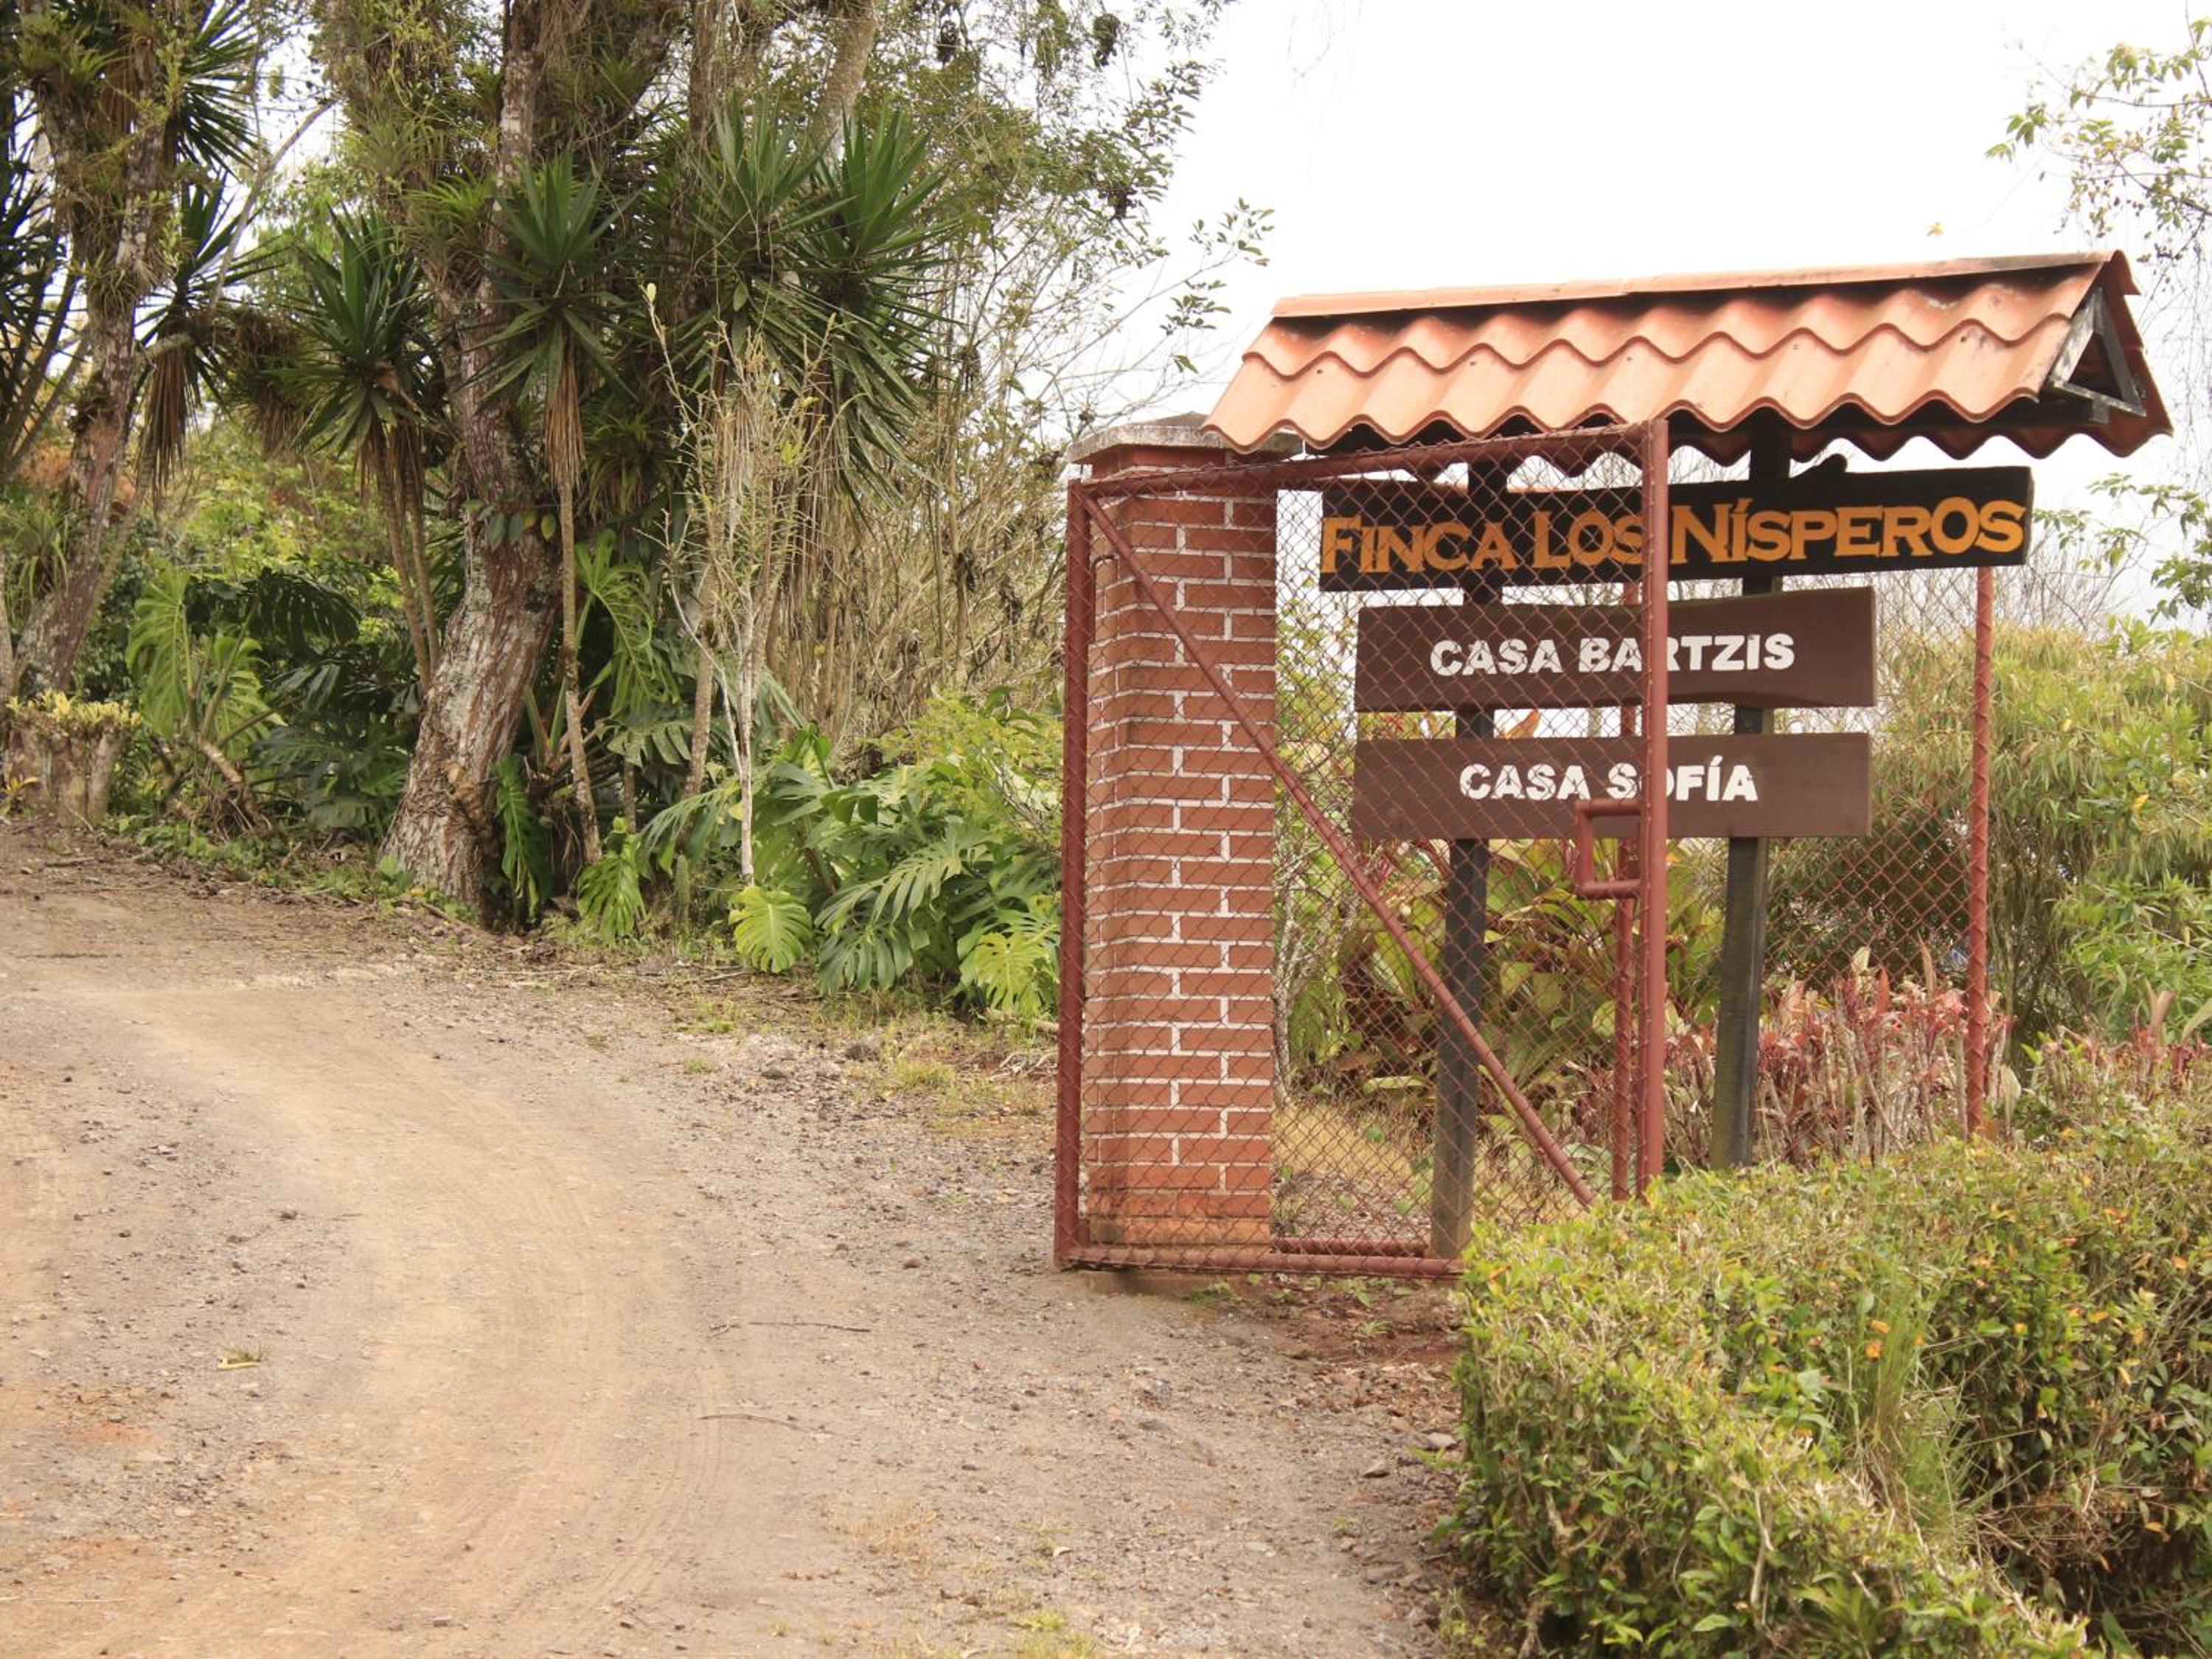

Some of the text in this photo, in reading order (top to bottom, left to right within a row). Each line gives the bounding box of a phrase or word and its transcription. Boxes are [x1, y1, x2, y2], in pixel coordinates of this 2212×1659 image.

[1321, 497, 2027, 574] FINCA LOS NÍSPEROS
[1430, 639, 1562, 676] CASA
[1459, 754, 1758, 801] CASA SFÍA
